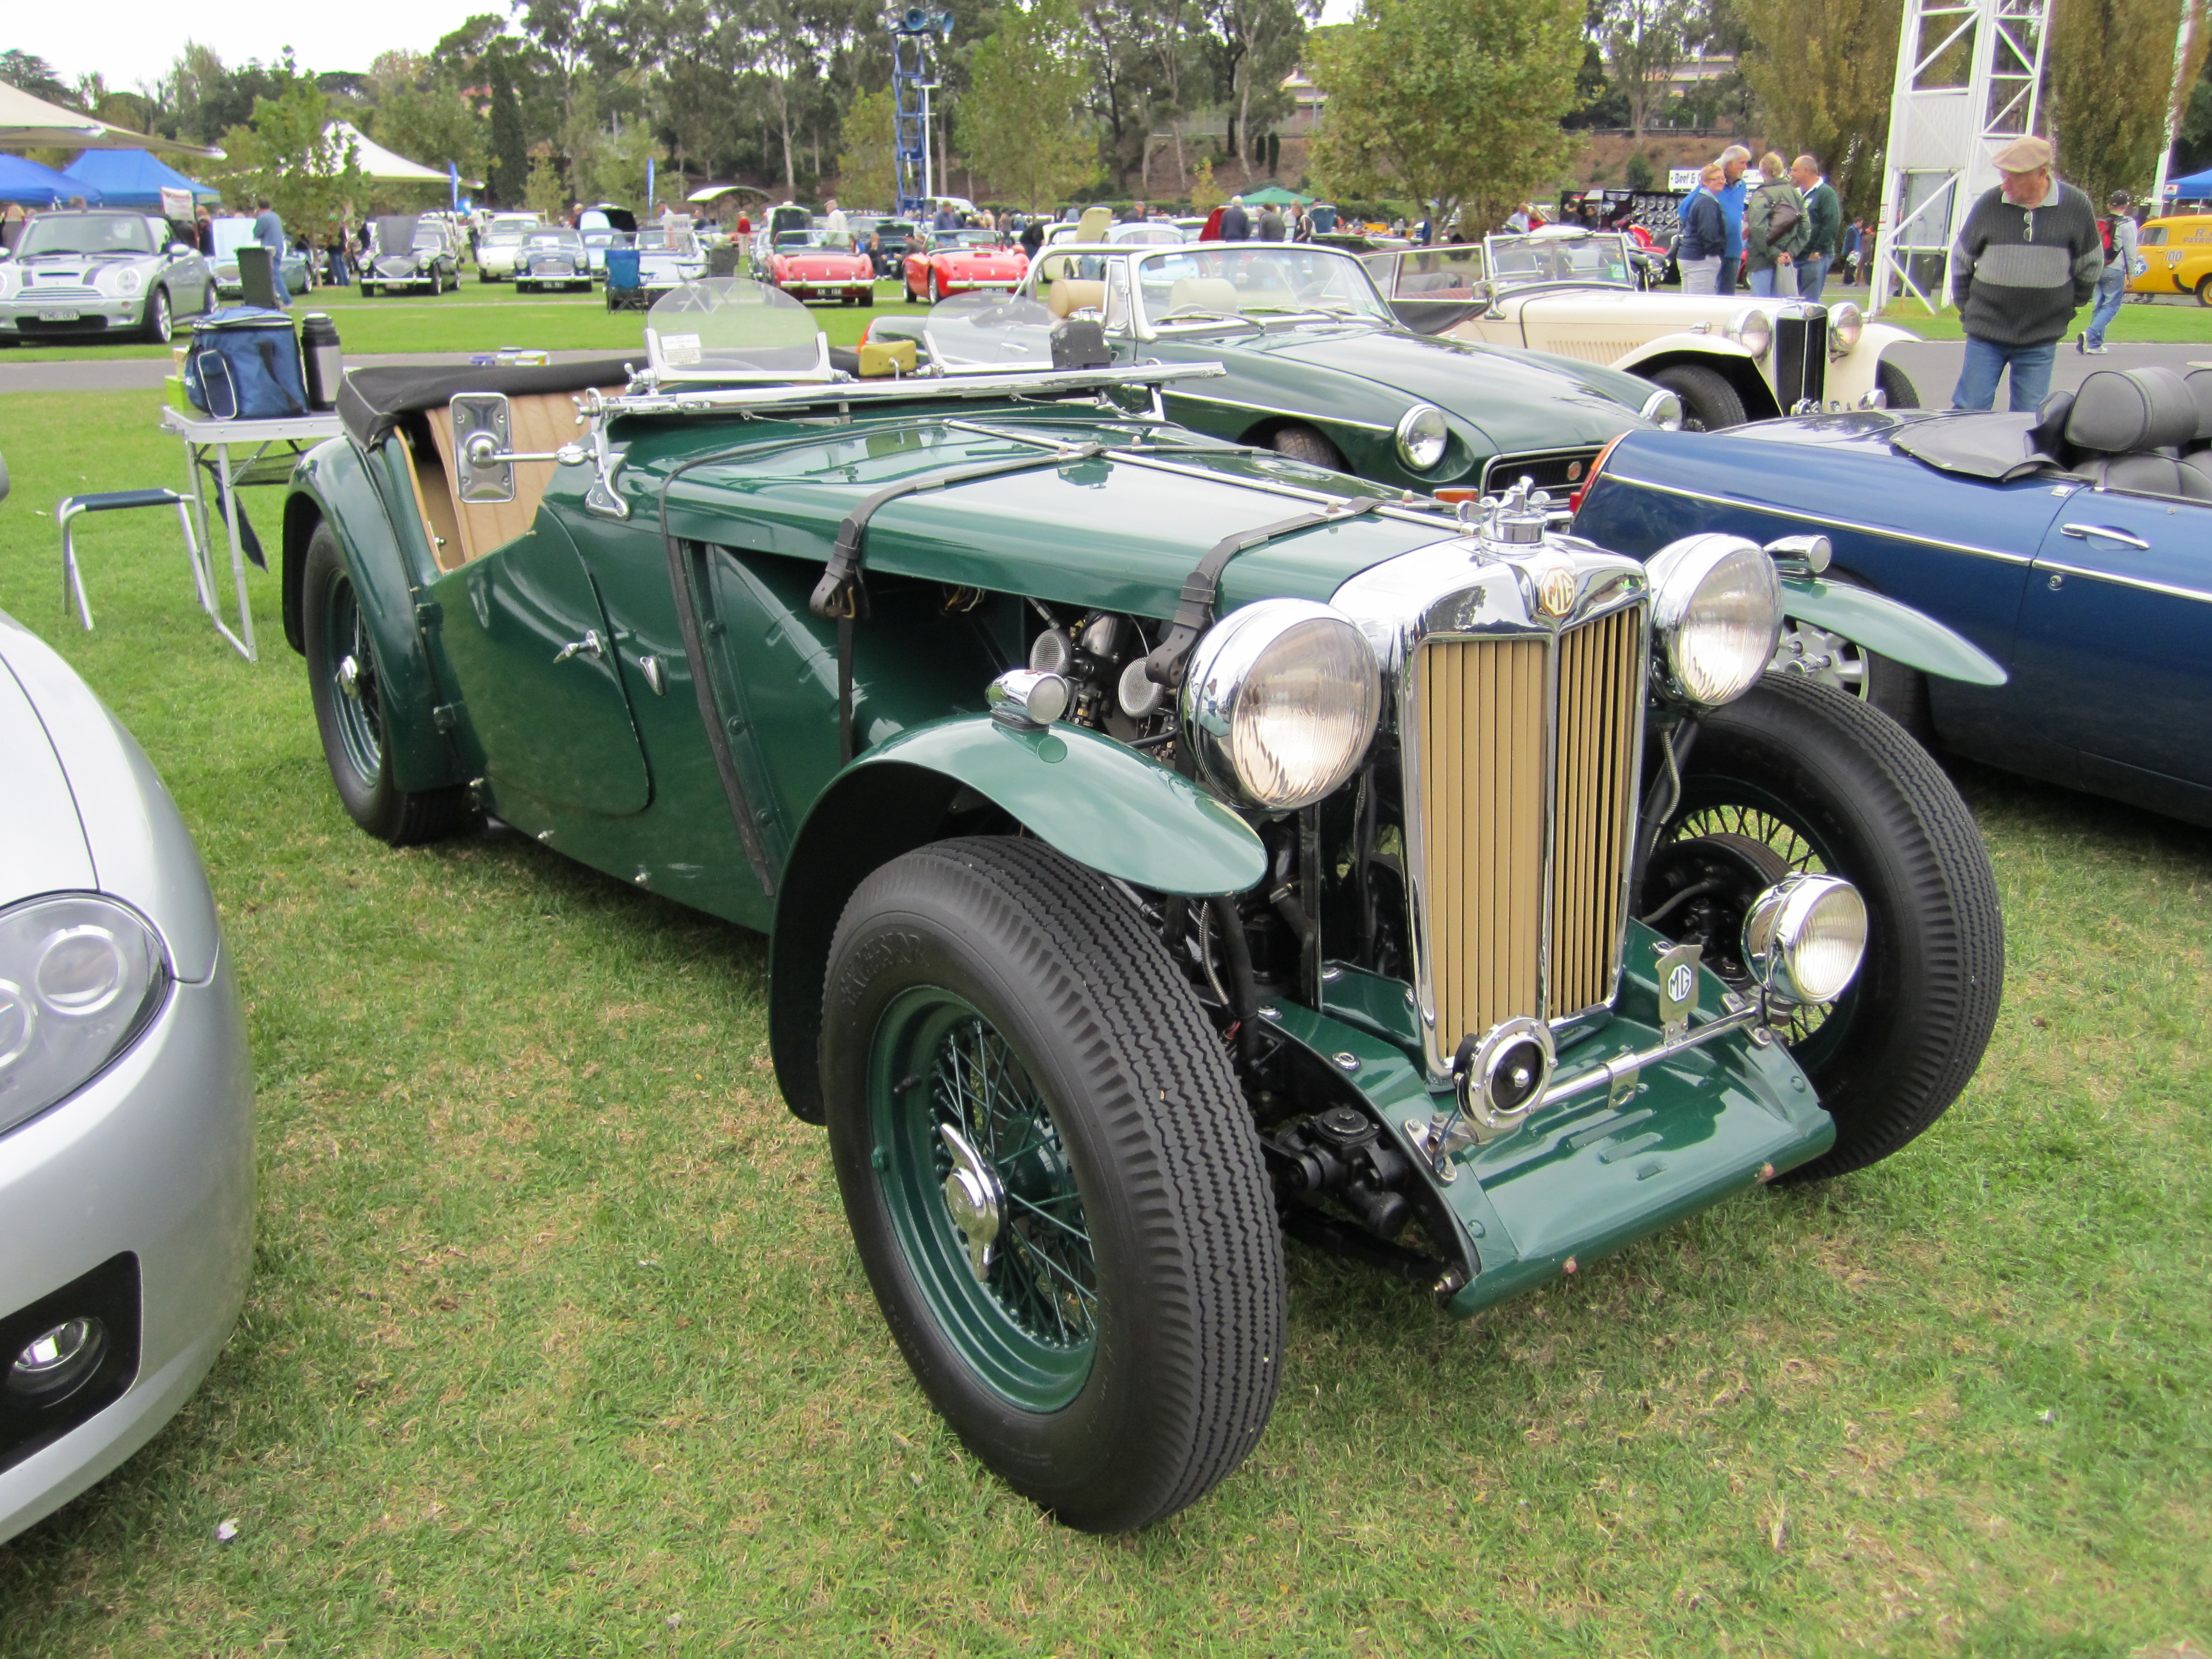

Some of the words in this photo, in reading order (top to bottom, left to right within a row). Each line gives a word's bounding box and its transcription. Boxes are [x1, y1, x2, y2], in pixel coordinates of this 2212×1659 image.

[1674, 173, 1689, 184] Beef
[1690, 173, 1695, 183] &
[2164, 250, 2183, 262] 100
[1547, 574, 1573, 612] MG
[1669, 966, 1690, 999] MG
